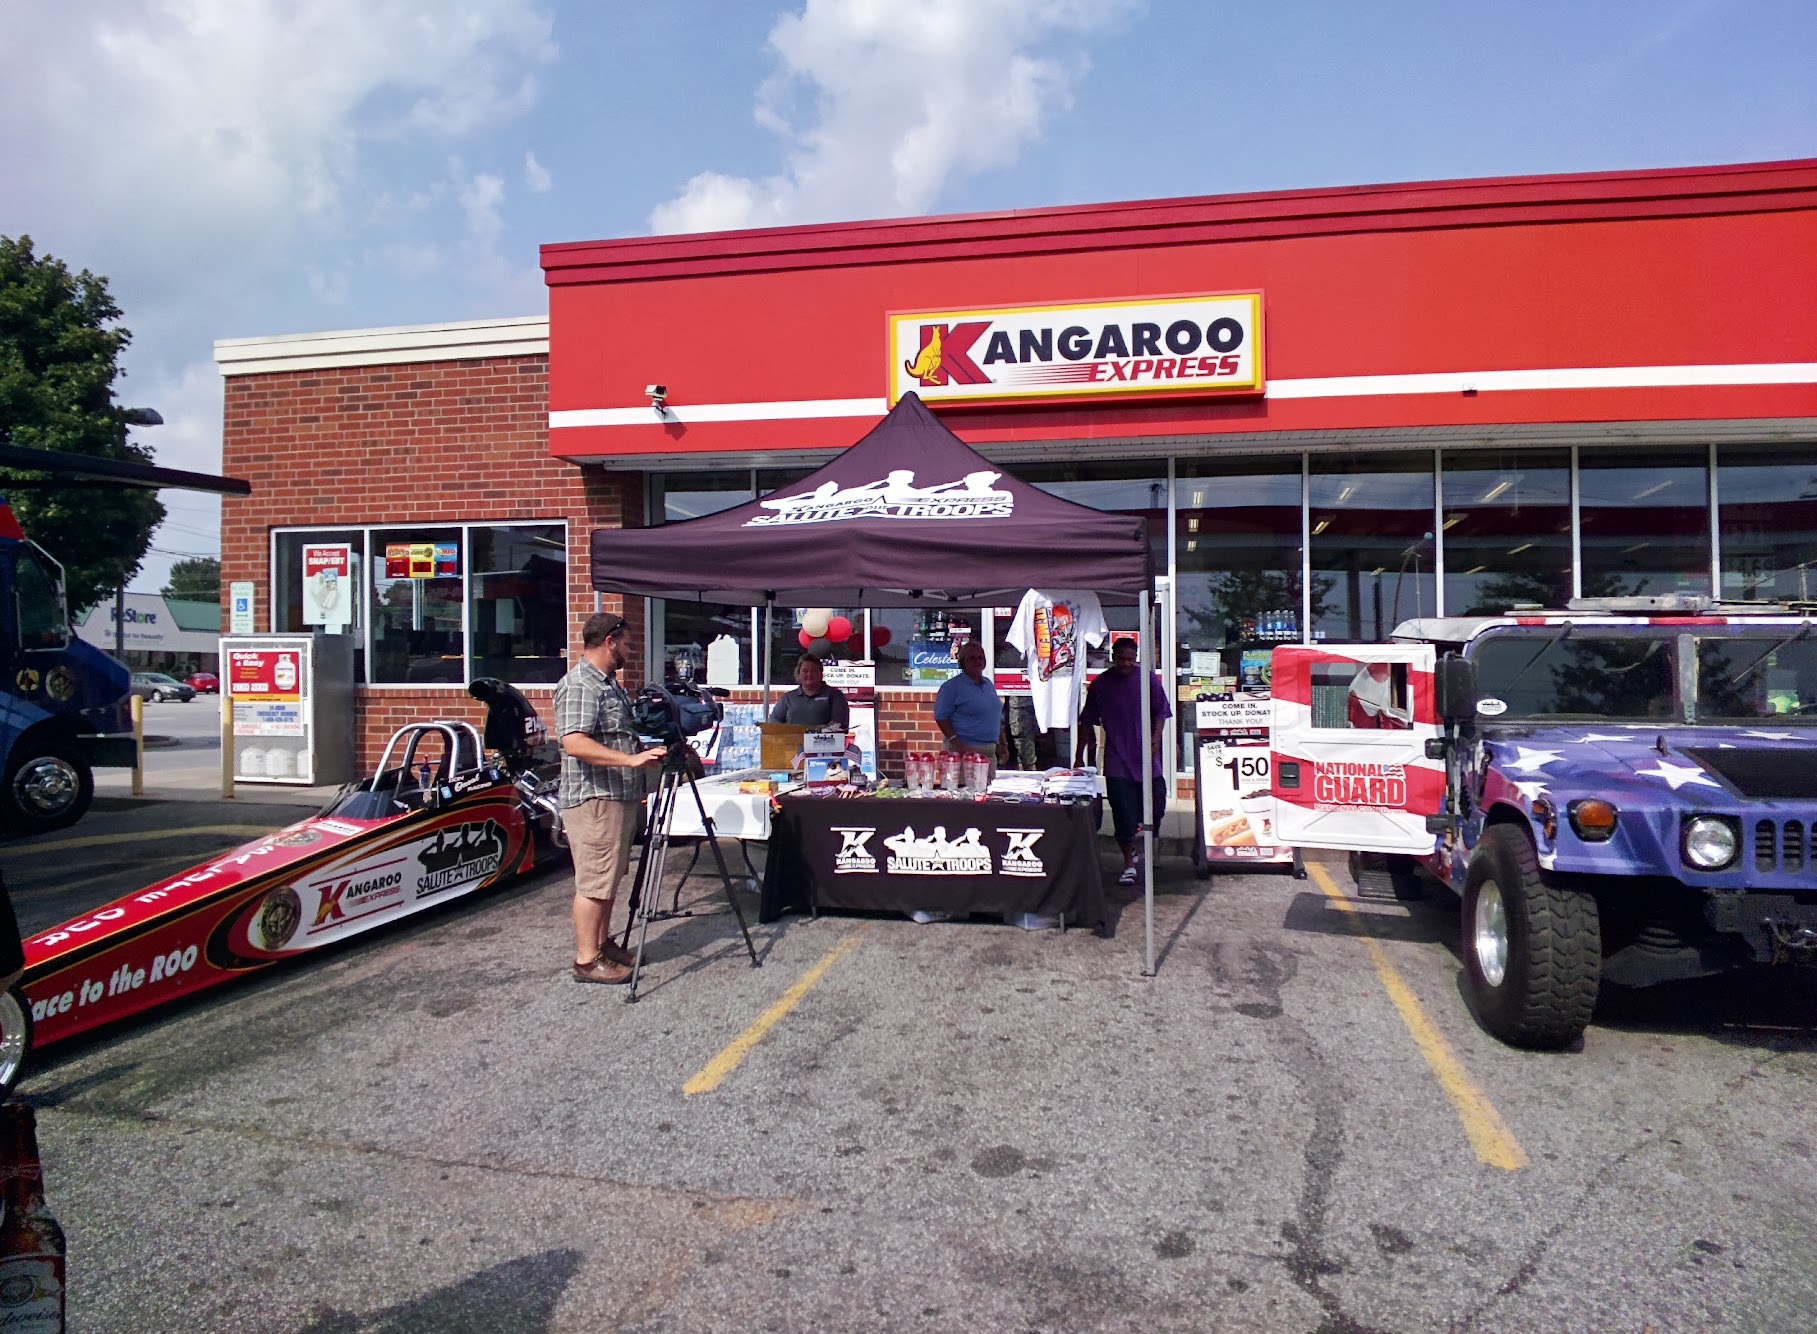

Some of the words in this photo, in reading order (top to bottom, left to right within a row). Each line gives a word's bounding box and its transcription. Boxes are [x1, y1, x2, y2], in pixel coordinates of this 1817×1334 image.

[917, 317, 1244, 387] KANGAROO
[1089, 354, 1240, 382] EXPRESS
[751, 507, 856, 523] SALUTE
[897, 503, 1014, 516] TROOPS
[790, 497, 873, 512] KANGAROO
[918, 496, 1007, 504] EXPRESS
[111, 608, 156, 624] RStore
[233, 652, 258, 660] Quick
[1314, 761, 1383, 776] NATIONAL
[1314, 775, 1406, 806] GUARD
[416, 869, 453, 894] SALUTE
[466, 854, 498, 878] TROOPS
[887, 857, 930, 871] SALUTE
[945, 857, 992, 871] TROOPS
[317, 872, 402, 923] KANGAROO
[28, 990, 74, 1023] ace
[78, 978, 104, 1007] to
[108, 964, 146, 997] the
[150, 944, 198, 983] ROO
